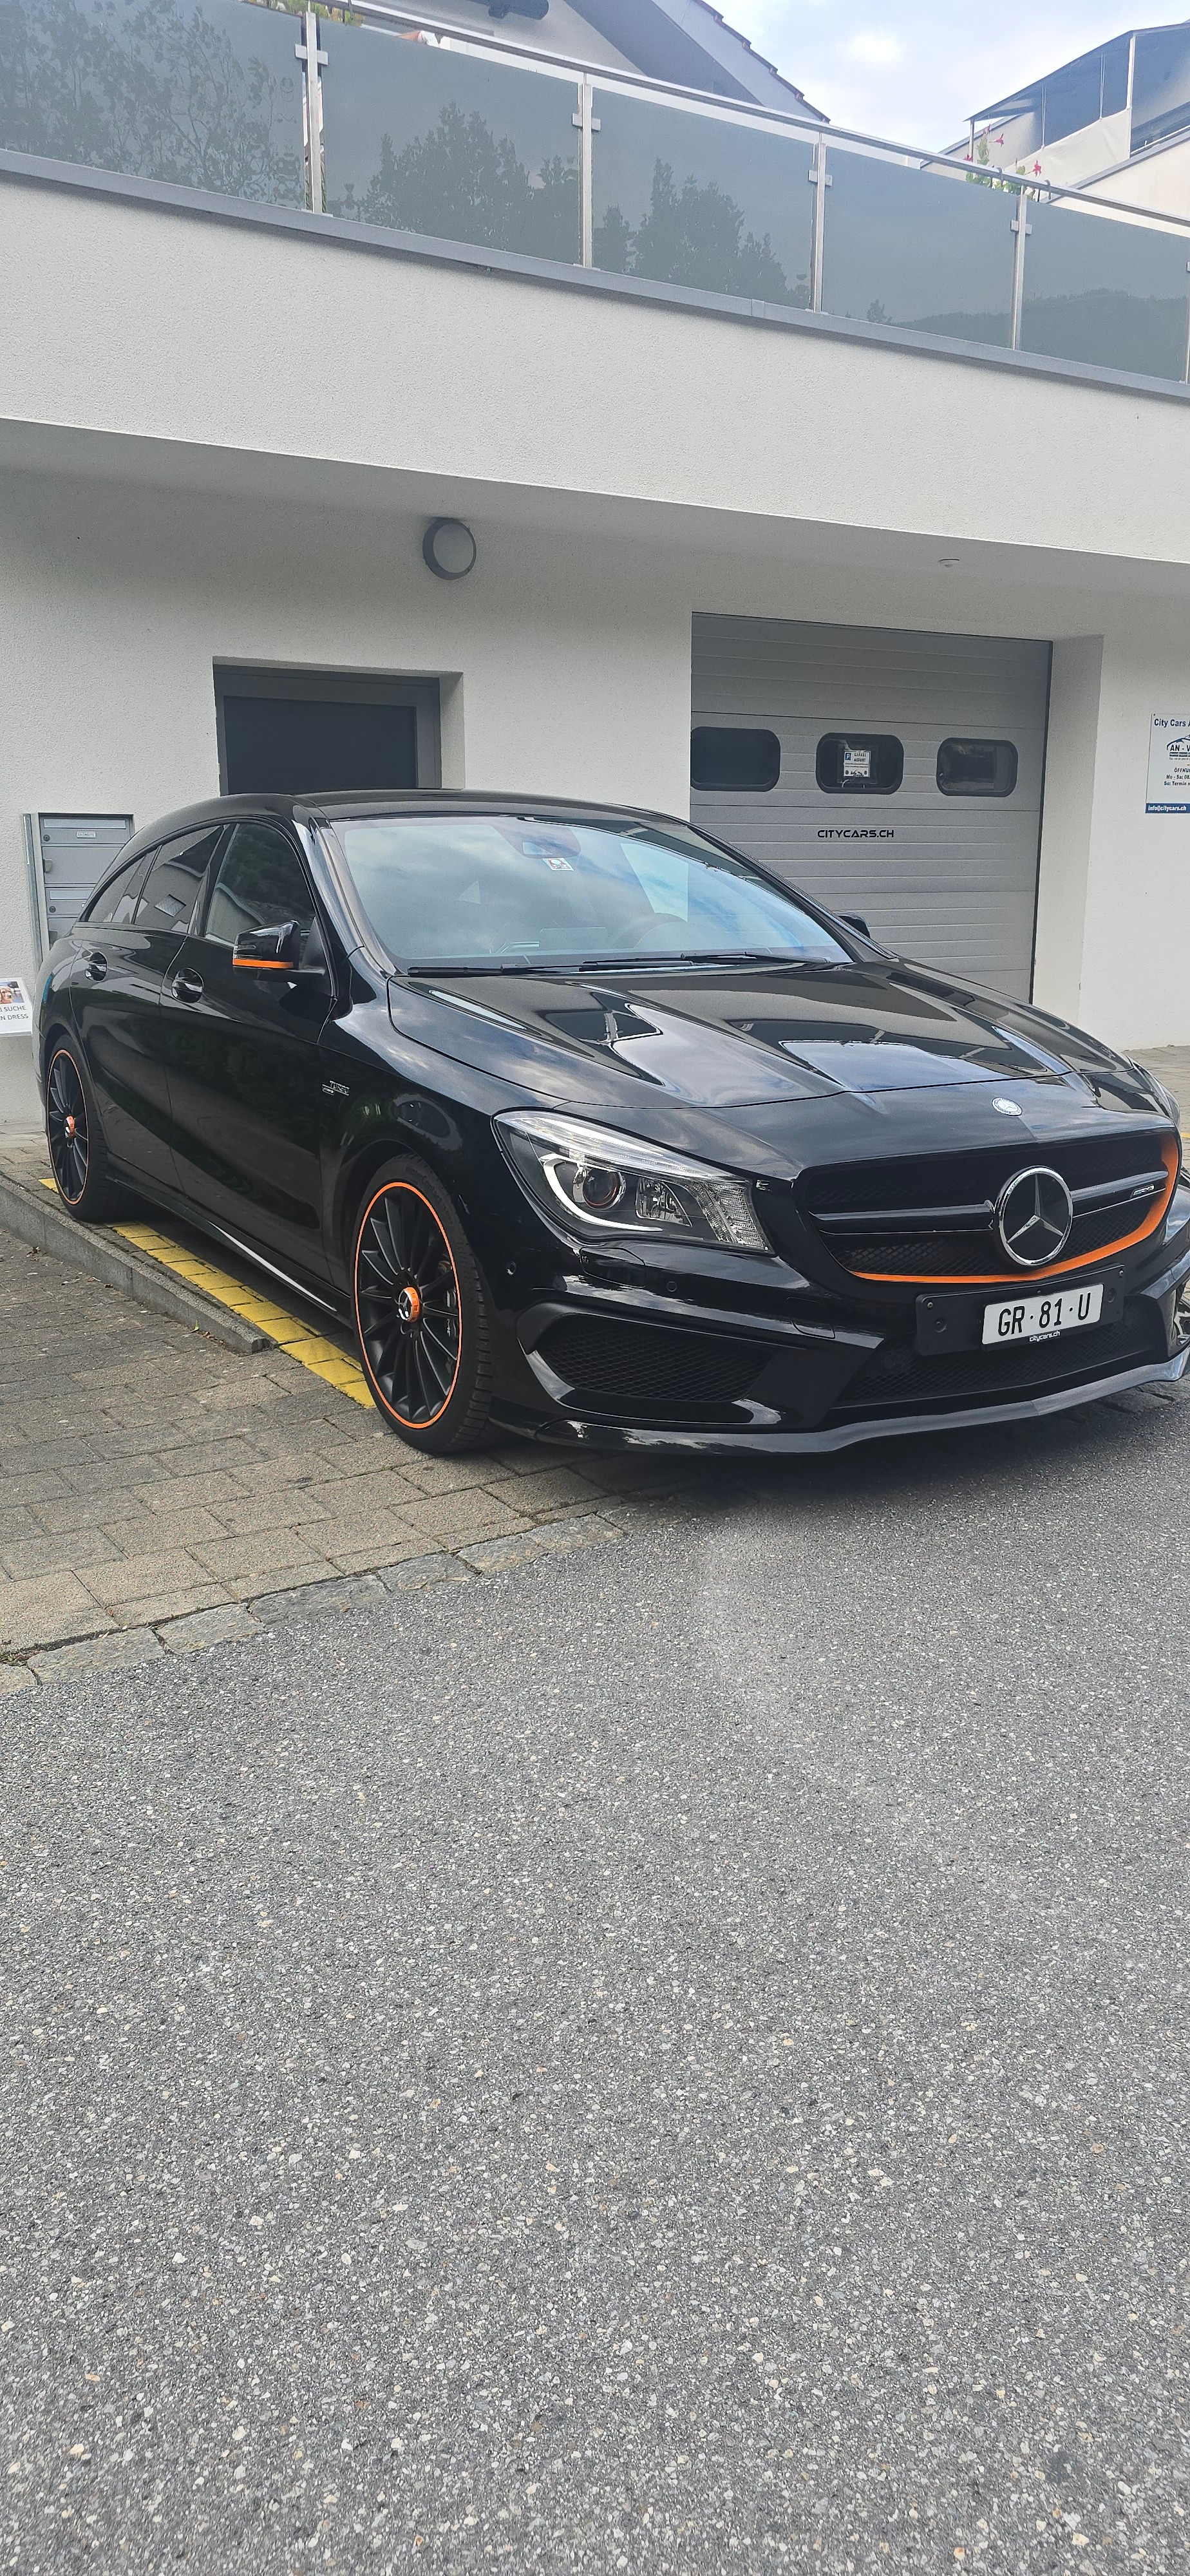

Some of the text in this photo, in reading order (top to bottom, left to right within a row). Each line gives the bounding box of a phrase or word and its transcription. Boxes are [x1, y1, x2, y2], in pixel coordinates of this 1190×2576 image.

[1154, 718, 1168, 728] City
[1170, 719, 1186, 727] Cars
[817, 829, 894, 838] CITYCARS.CH
[1029, 1330, 1061, 1342] citycars.ch
